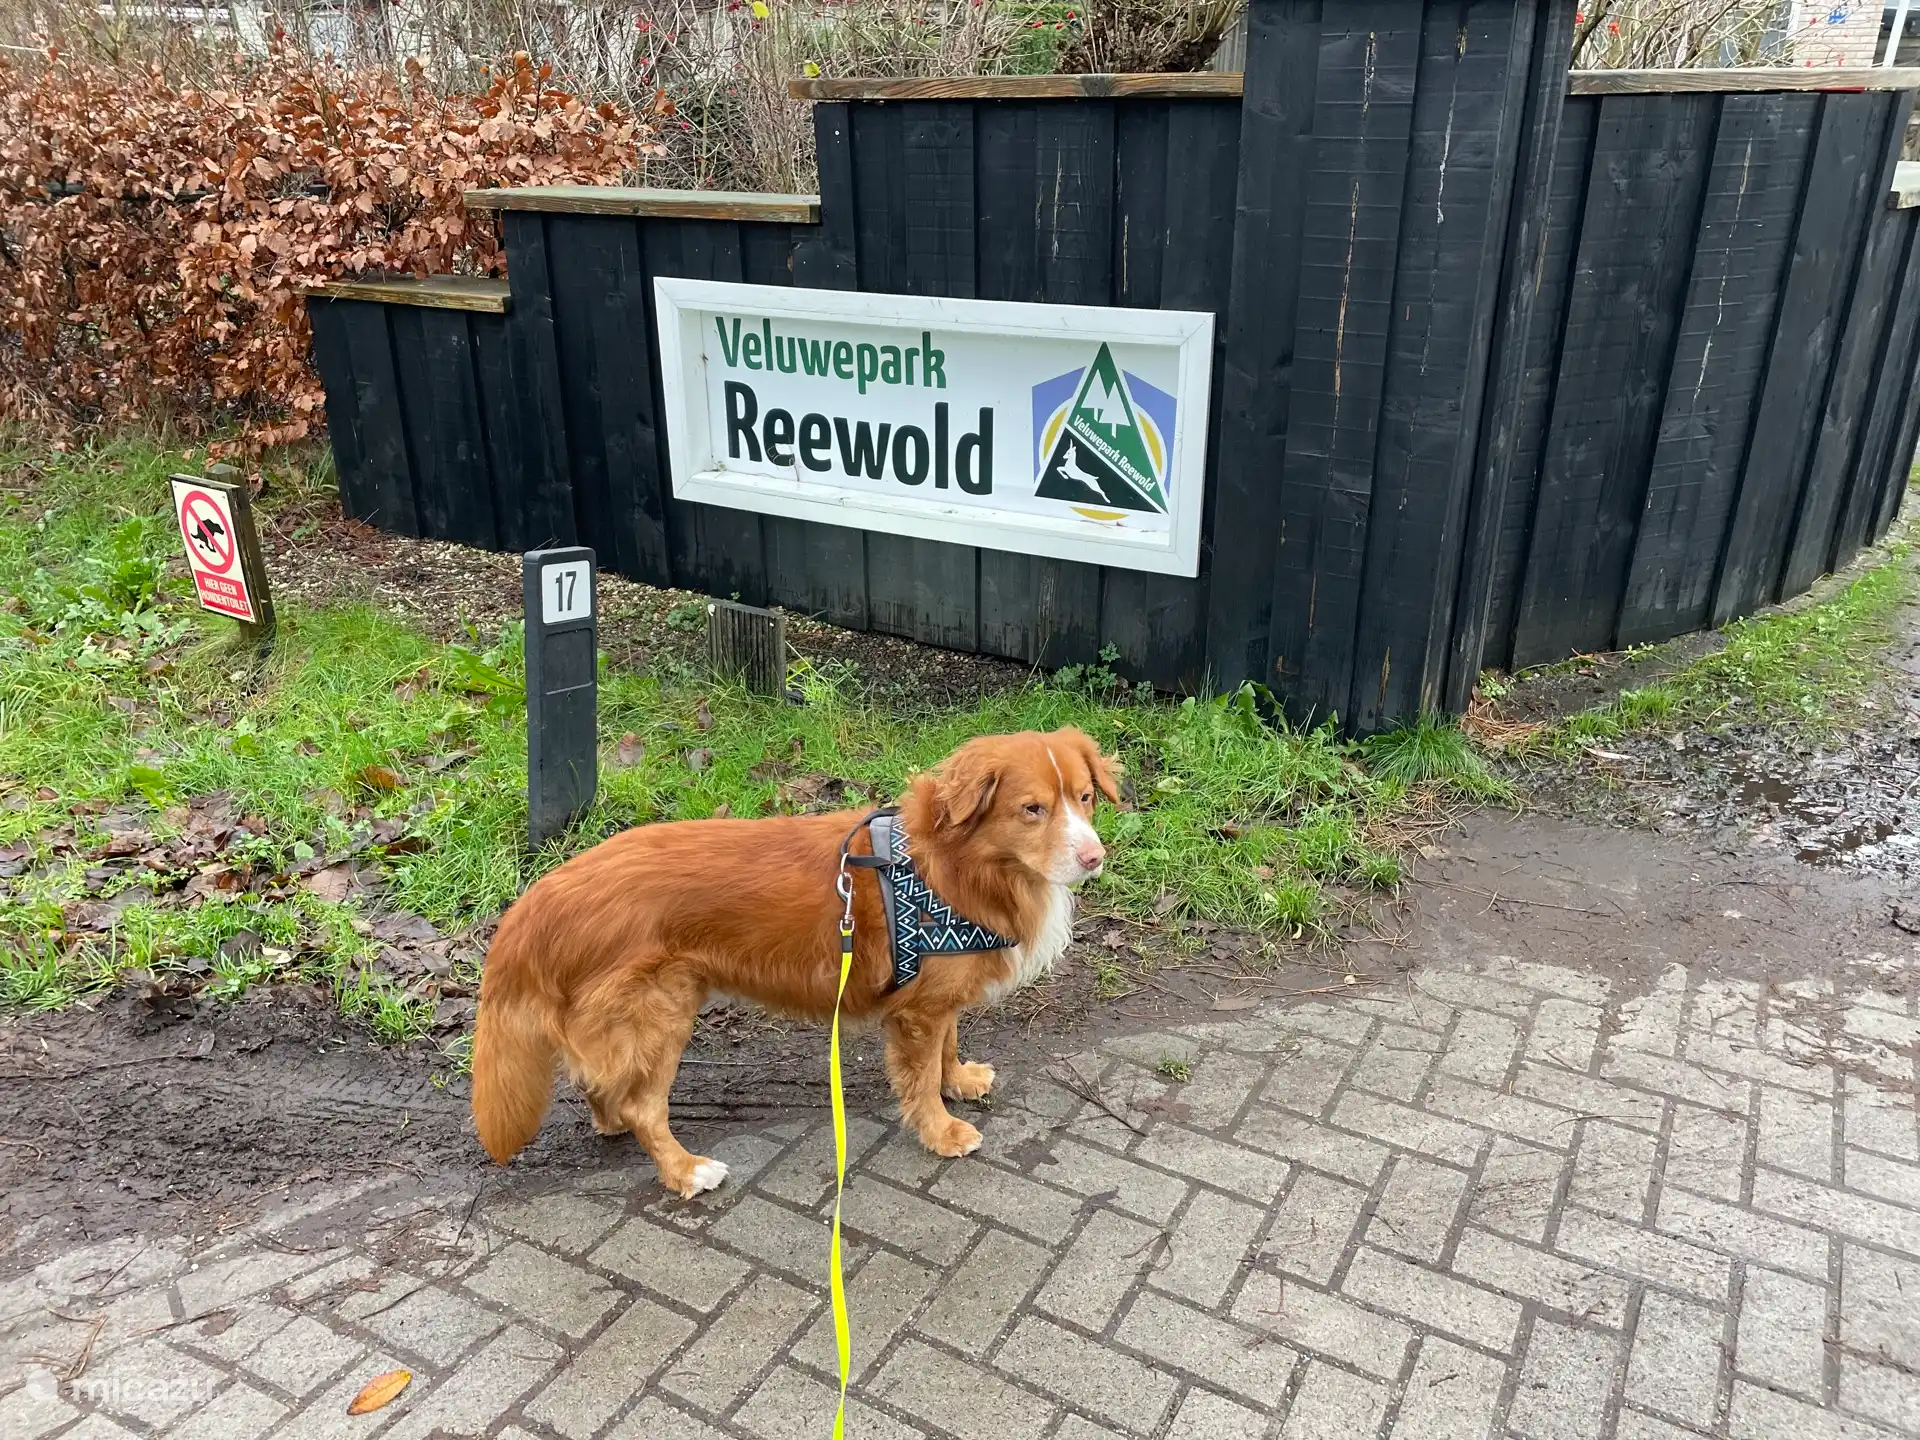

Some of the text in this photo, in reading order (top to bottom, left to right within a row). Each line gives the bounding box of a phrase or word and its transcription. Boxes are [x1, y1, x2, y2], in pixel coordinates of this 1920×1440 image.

[715, 316, 947, 395] Veluwepark
[724, 381, 994, 495] Reewold
[1073, 414, 1156, 492] Veluwepark Reewold
[204, 577, 237, 596] HIER GEEN
[555, 571, 577, 612] 17
